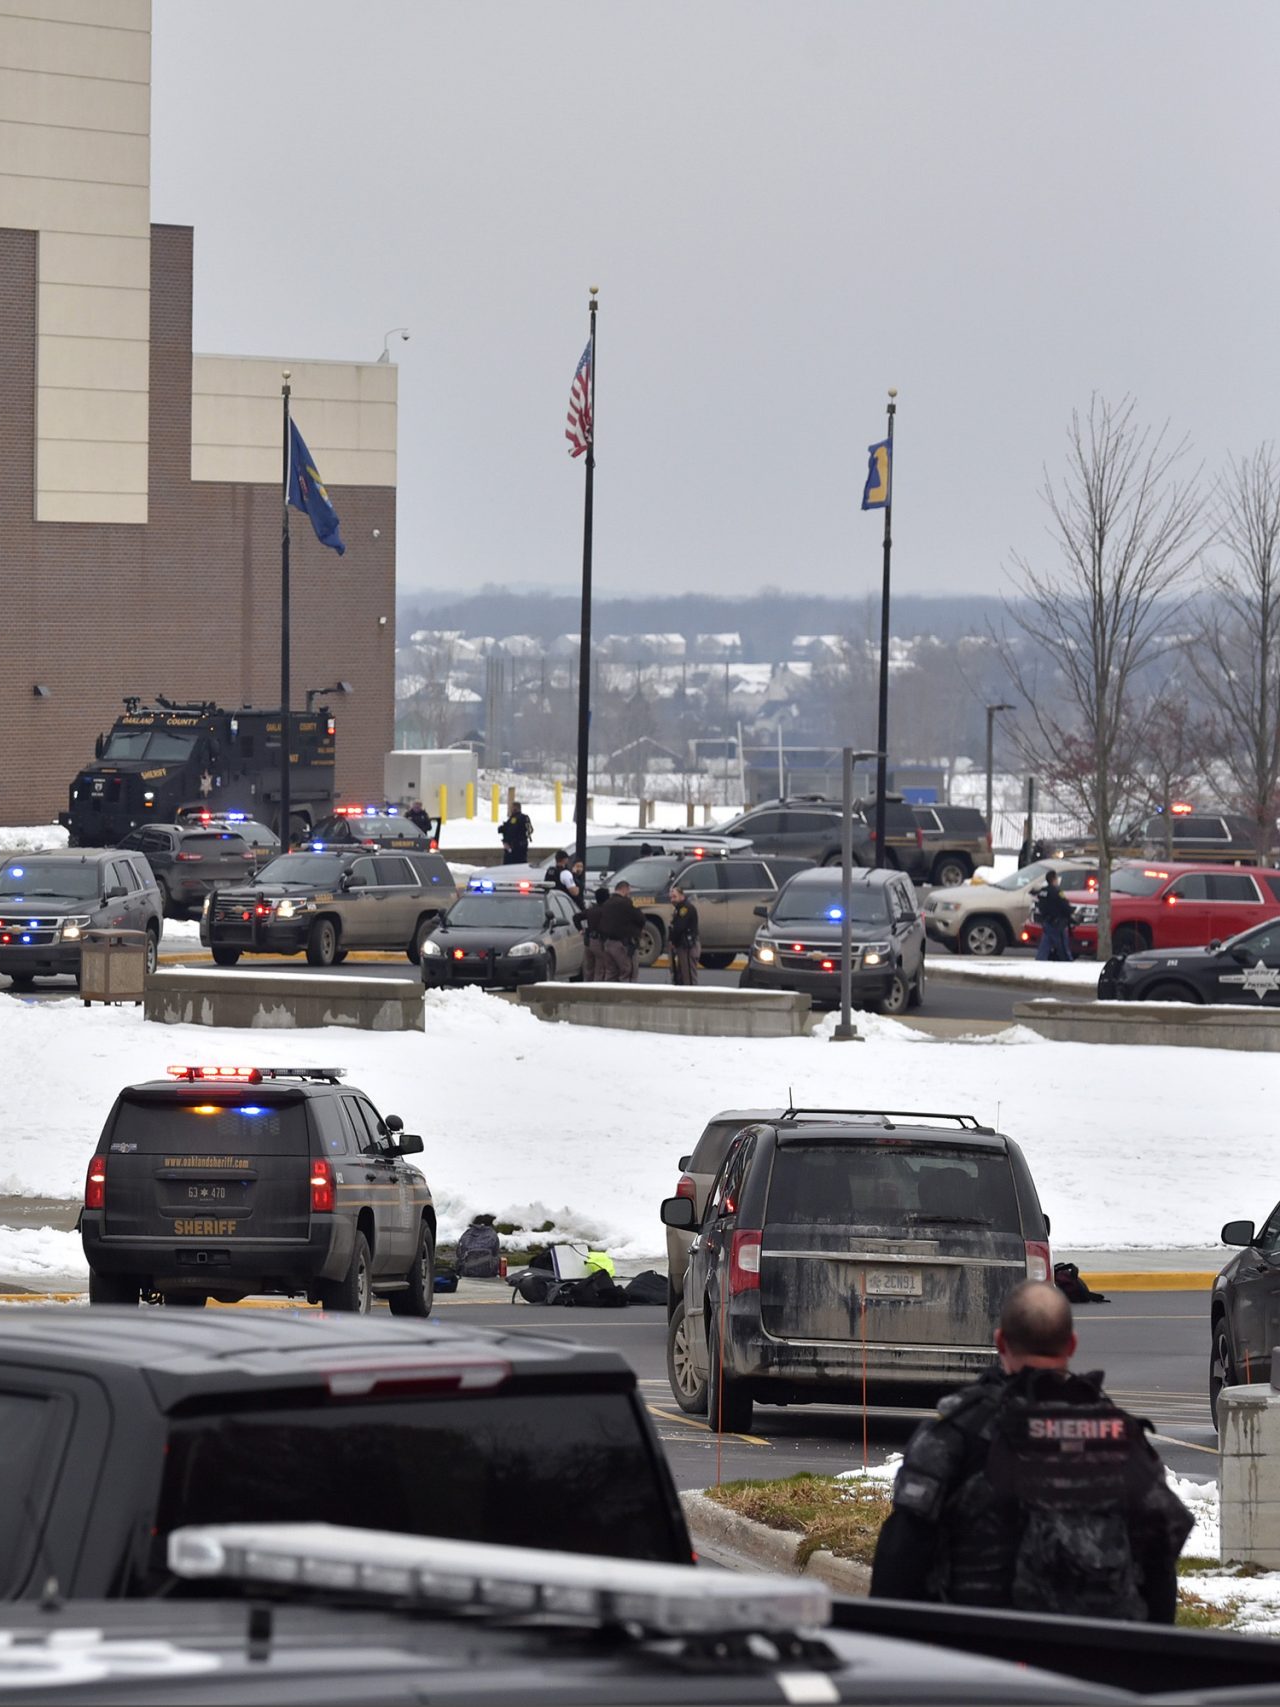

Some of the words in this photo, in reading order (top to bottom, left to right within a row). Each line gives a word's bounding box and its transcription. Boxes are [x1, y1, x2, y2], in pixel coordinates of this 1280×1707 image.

[122, 717, 154, 726] OAKLAND
[166, 718, 200, 726] COUNTY
[164, 1156, 249, 1168] www.oaklandsheriff.com
[188, 1187, 198, 1198] 63
[211, 1187, 226, 1198] 470
[174, 1220, 237, 1235] SHERIFF
[1028, 1418, 1125, 1439] SHERIFF
